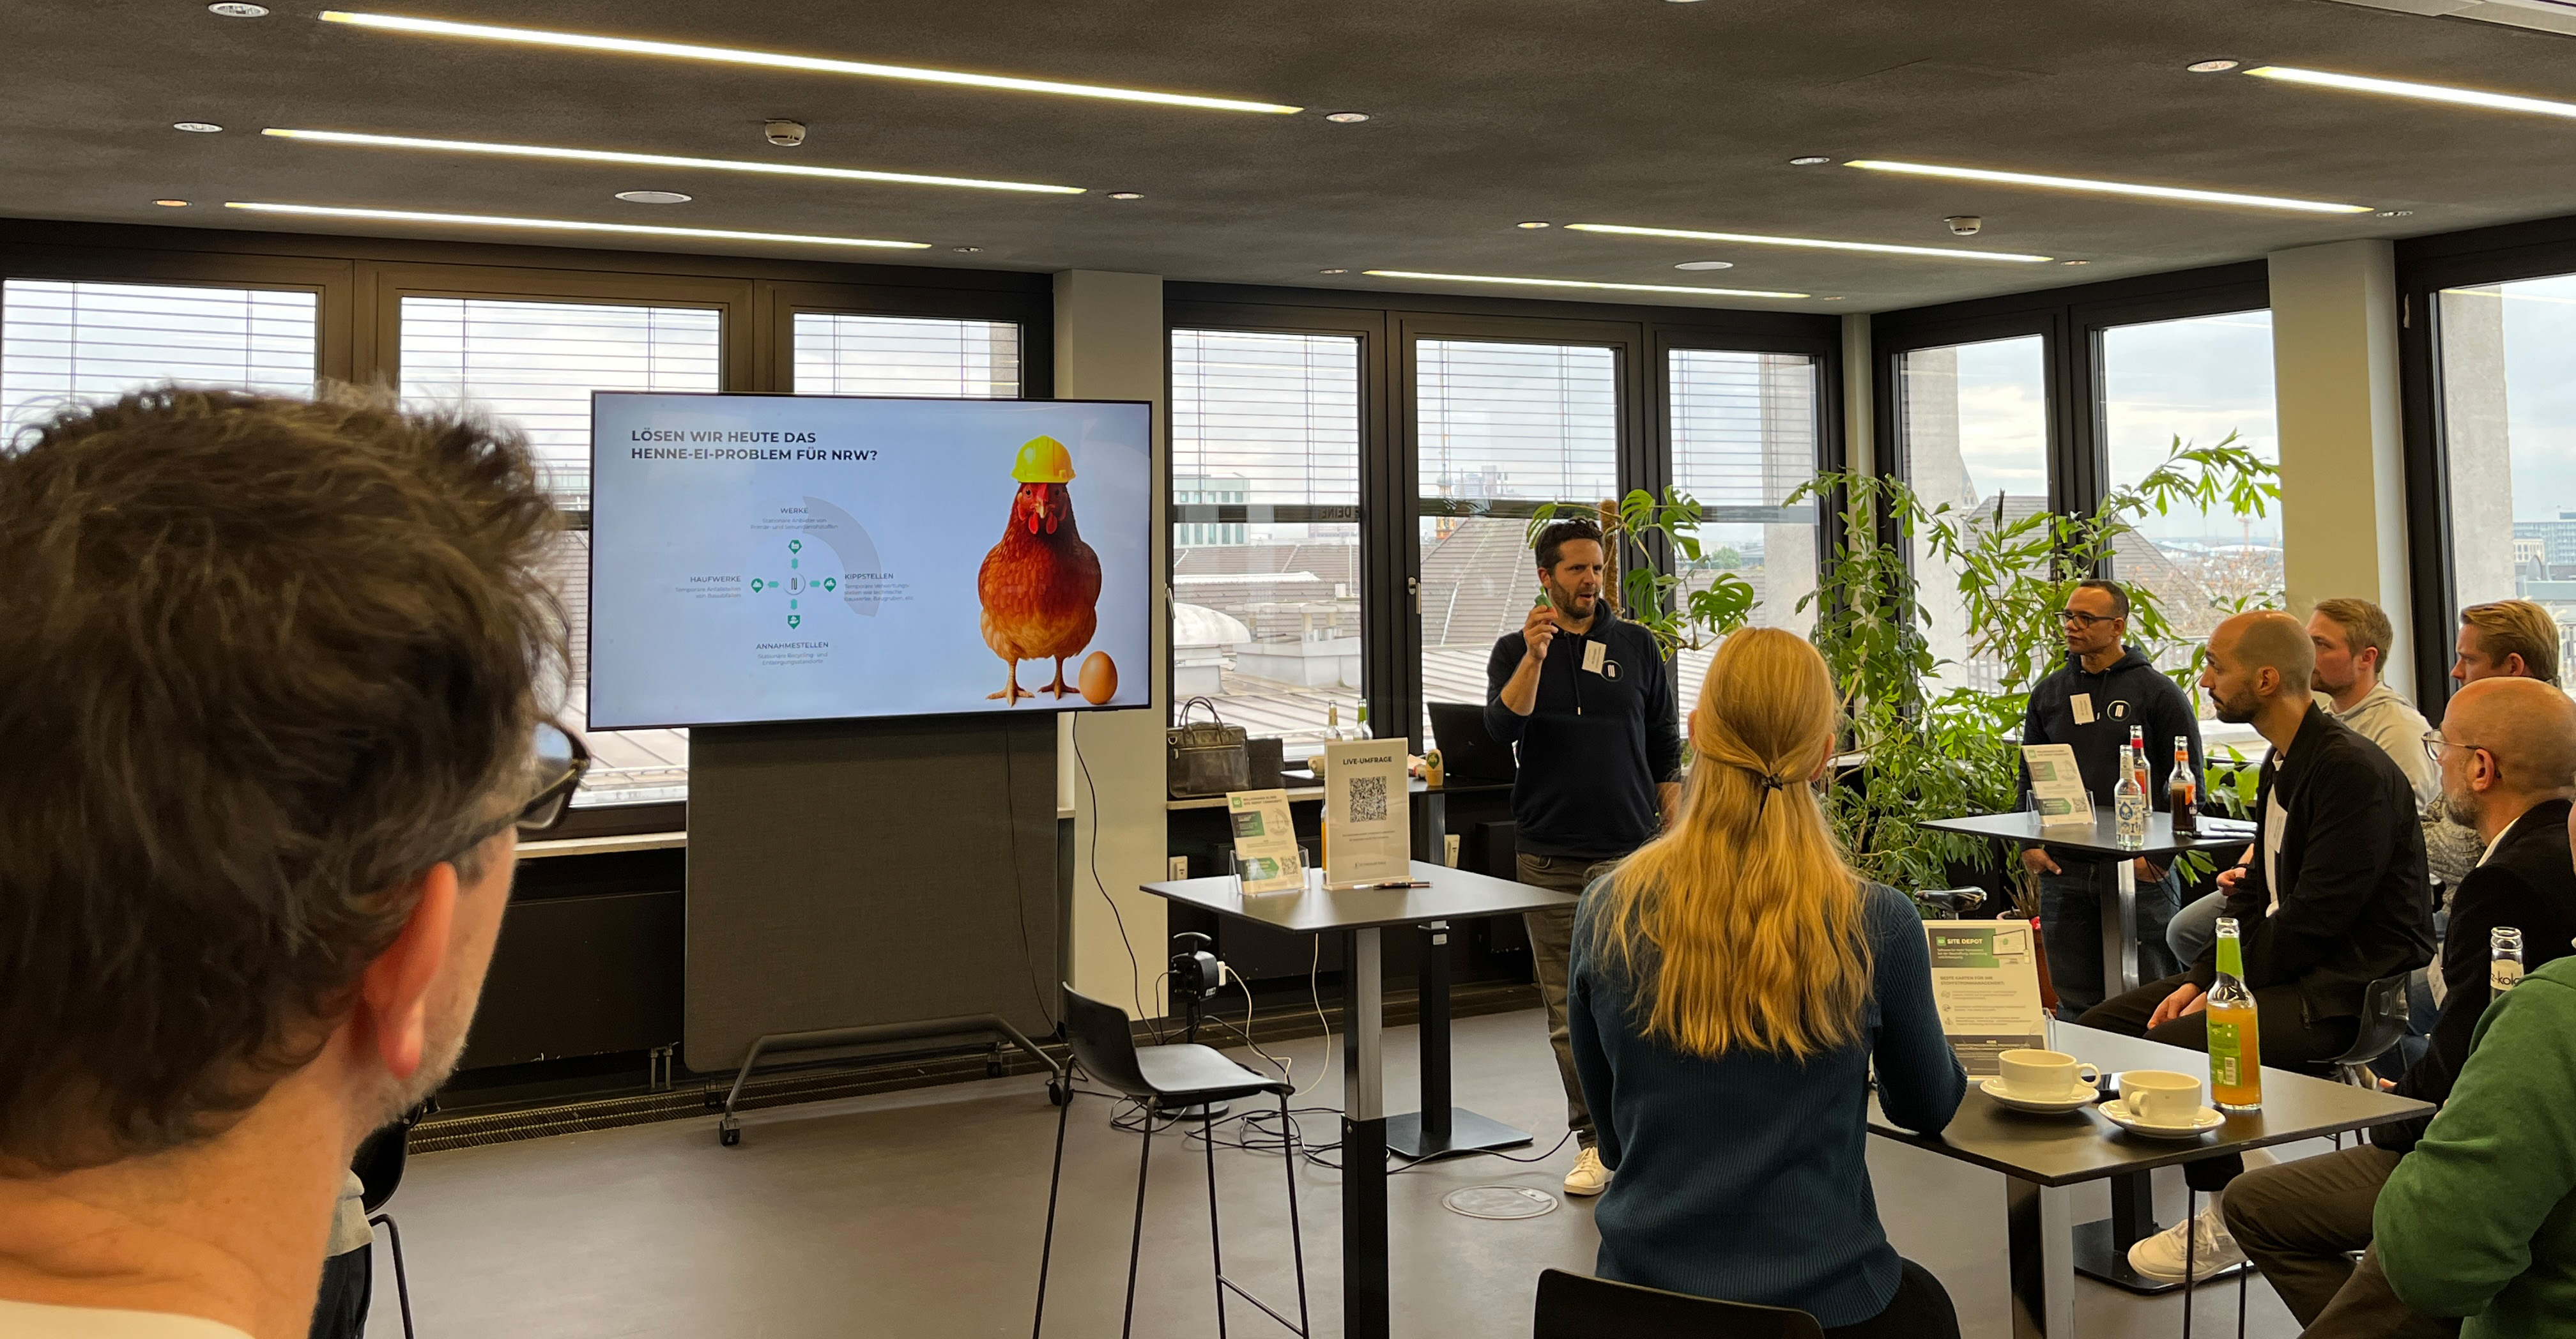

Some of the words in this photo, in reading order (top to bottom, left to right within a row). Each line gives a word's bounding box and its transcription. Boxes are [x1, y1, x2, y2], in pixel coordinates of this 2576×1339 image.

[632, 427, 685, 442] LÖSEN
[691, 431, 723, 443] WIR
[728, 431, 779, 443] HEUTE
[784, 432, 816, 443] DAS
[631, 448, 792, 460] HENNE-EI-PROBLEM
[797, 447, 827, 461] FÜR
[832, 449, 878, 461] NRW?
[756, 641, 829, 650] ANNAHMESTELLEN
[1343, 756, 1392, 765] LIVE-UMFRAGE
